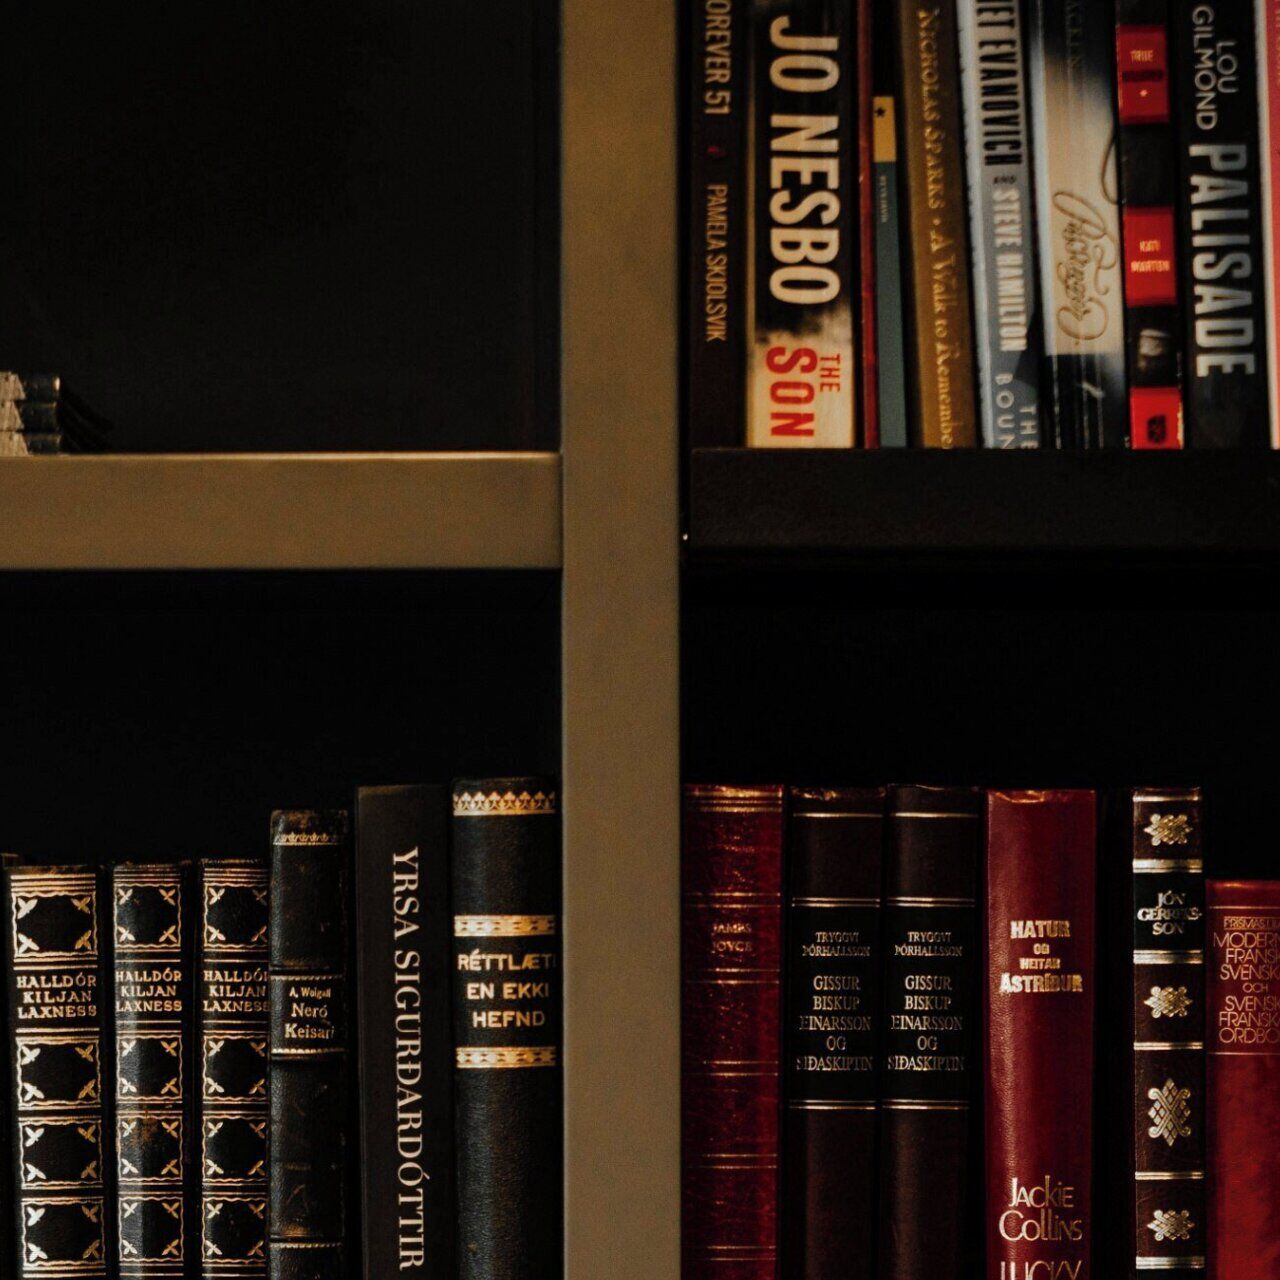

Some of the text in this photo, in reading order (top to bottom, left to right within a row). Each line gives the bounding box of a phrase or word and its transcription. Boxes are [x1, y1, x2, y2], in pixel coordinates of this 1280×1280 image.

[917, 10, 940, 121] NICHOLAS
[1191, 4, 1218, 130] GILMOND
[1215, 40, 1238, 94] LOU
[704, 89, 732, 115] 51
[768, 15, 841, 305] JO NESBO
[923, 128, 944, 209] SPARKS
[980, 40, 1028, 352] EVANOVICH STEVE HAMILTON
[705, 184, 726, 250] PAMELA
[1188, 143, 1257, 378] PALISADE
[931, 256, 956, 314] Walk
[934, 318, 956, 337] to
[820, 354, 841, 393] THE
[766, 347, 818, 437] SON
[1019, 404, 1040, 449] THE
[392, 847, 421, 940] YRSA
[1010, 920, 1071, 939] HATUR
[1152, 921, 1185, 935] SON
[815, 932, 860, 943] TRYGGVI
[907, 932, 952, 943] TRYGGVI
[712, 940, 752, 954] JOYCE
[1034, 943, 1050, 955] OG
[1020, 957, 1061, 970] HEITAR
[16, 973, 97, 990] HALLDÓR
[115, 967, 182, 983] HALLDÓR
[813, 975, 861, 991] GISSUR
[905, 975, 952, 991] GISSUR
[121, 985, 177, 998] KILJAN
[209, 985, 266, 998] KILJAN
[467, 983, 549, 1000] EN EKKI
[1242, 983, 1269, 993] OCH
[23, 990, 92, 1005] KILJAN
[813, 996, 860, 1011] BISKUP
[905, 996, 952, 1011] BISKUP
[17, 1005, 98, 1020] LAXNESS
[115, 1000, 183, 1012] LAXNESS
[473, 1011, 545, 1028] HEFND
[800, 1016, 871, 1031] EINARSSON
[891, 1016, 963, 1031] EINARSSON
[285, 1023, 335, 1040] Keisari
[826, 1036, 846, 1051] OG
[917, 1036, 938, 1051] OG
[394, 949, 430, 1272] SIGURÐARDÓTTIR
